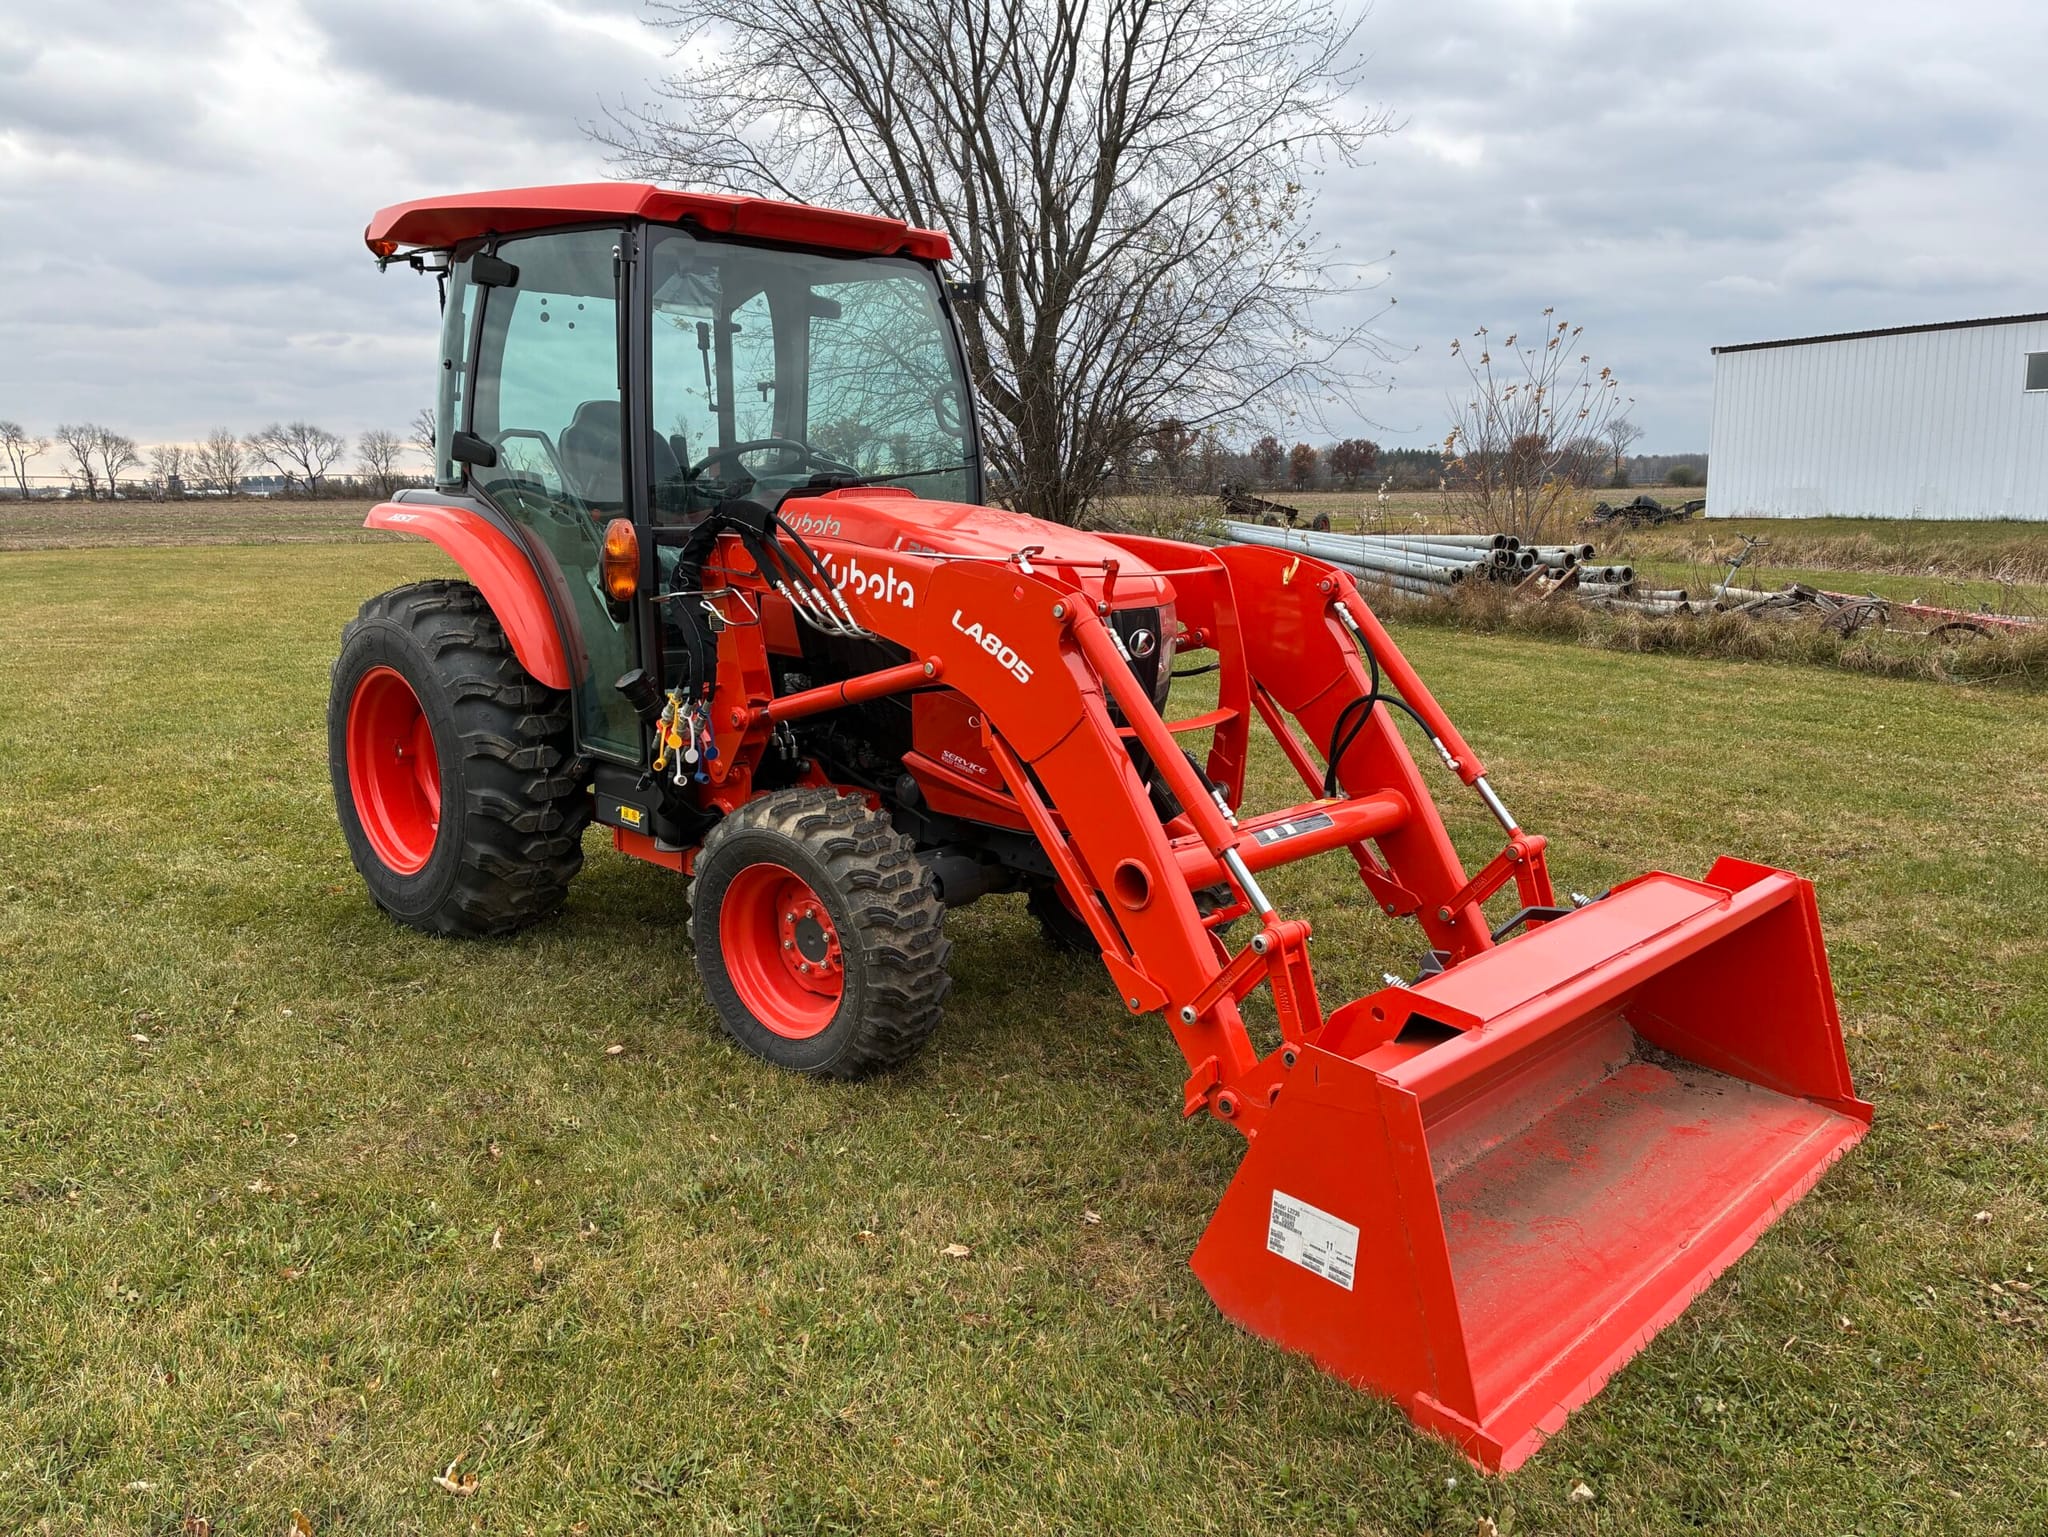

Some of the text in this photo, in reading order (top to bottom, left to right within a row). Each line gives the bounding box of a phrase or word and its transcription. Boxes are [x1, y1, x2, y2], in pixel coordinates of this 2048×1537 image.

[780, 511, 841, 536] Kubota
[812, 550, 914, 608] Kubota
[952, 609, 1034, 683] LA805
[943, 750, 988, 775] SERVICE
